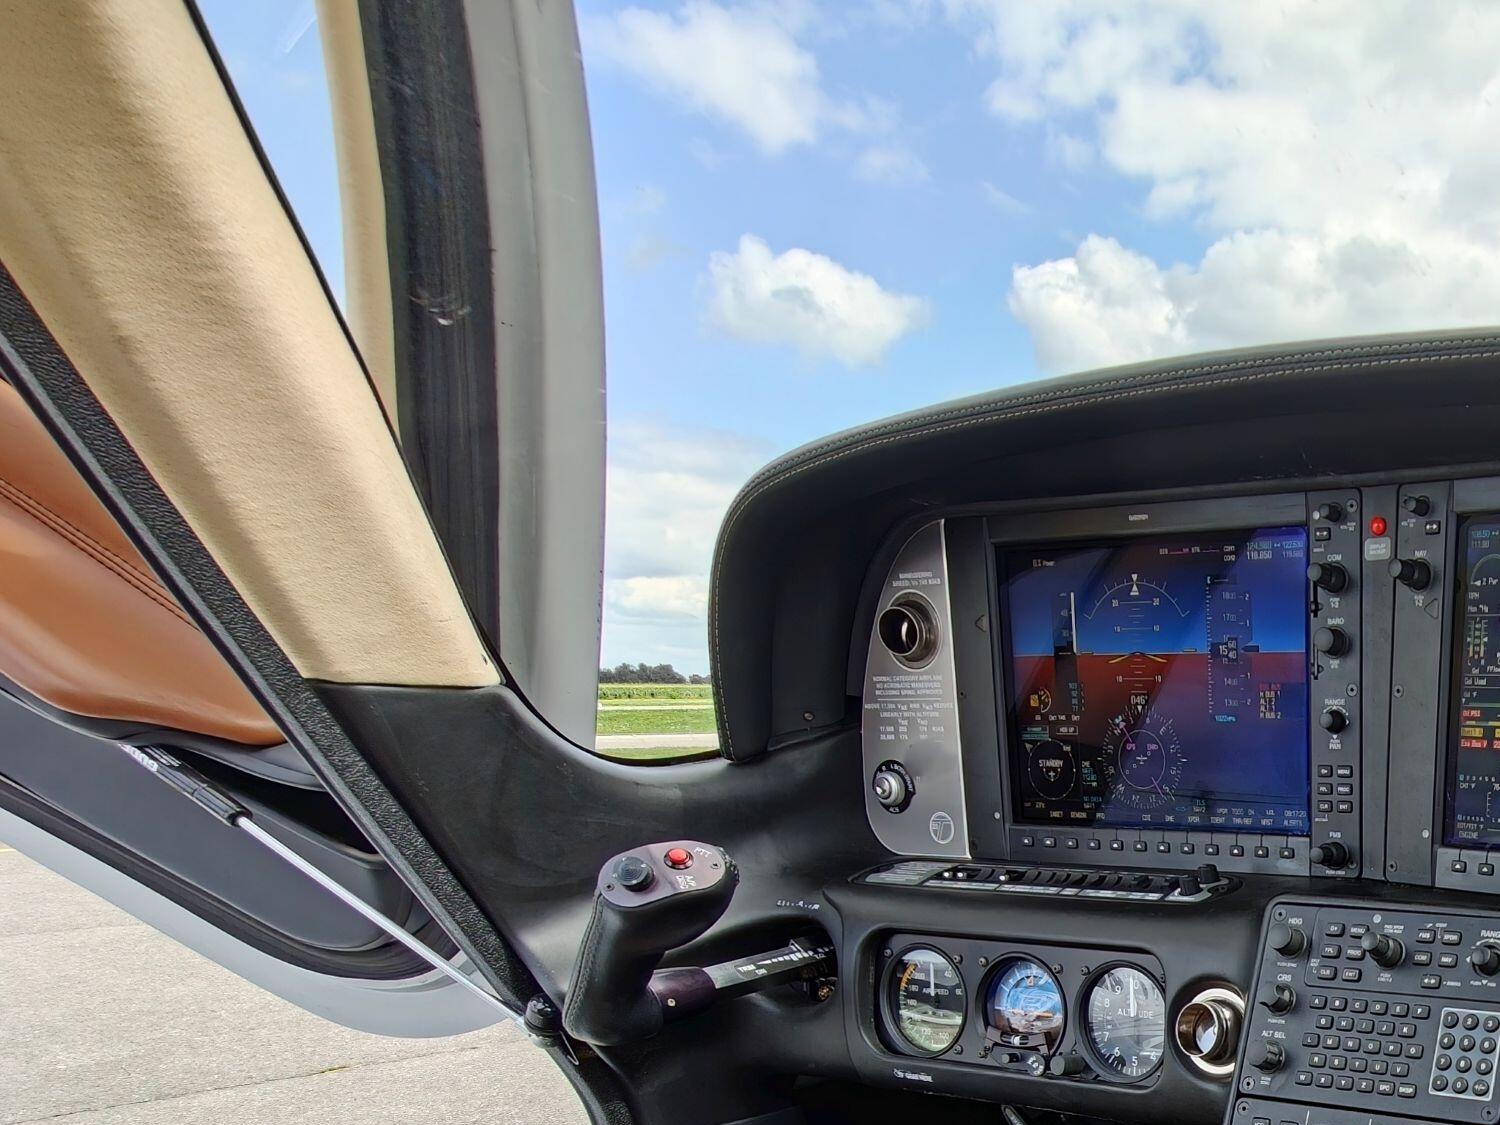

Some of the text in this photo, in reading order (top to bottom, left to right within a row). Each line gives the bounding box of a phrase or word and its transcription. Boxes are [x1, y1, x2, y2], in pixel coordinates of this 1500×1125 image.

[1327, 553, 1342, 561] COM
[1414, 549, 1428, 558] NAV
[1327, 617, 1345, 625] BARO
[1325, 698, 1346, 706] RANGE
[1277, 974, 1292, 982] CRS
[1114, 985, 1122, 995] 9
[1104, 998, 1111, 1008] 8
[1103, 1031, 1110, 1042] 7
[1261, 1030, 1286, 1039] ALT SEL
[1114, 1046, 1121, 1057] 6
[1150, 1051, 1158, 1061] 4
[1131, 1056, 1139, 1067] 5
